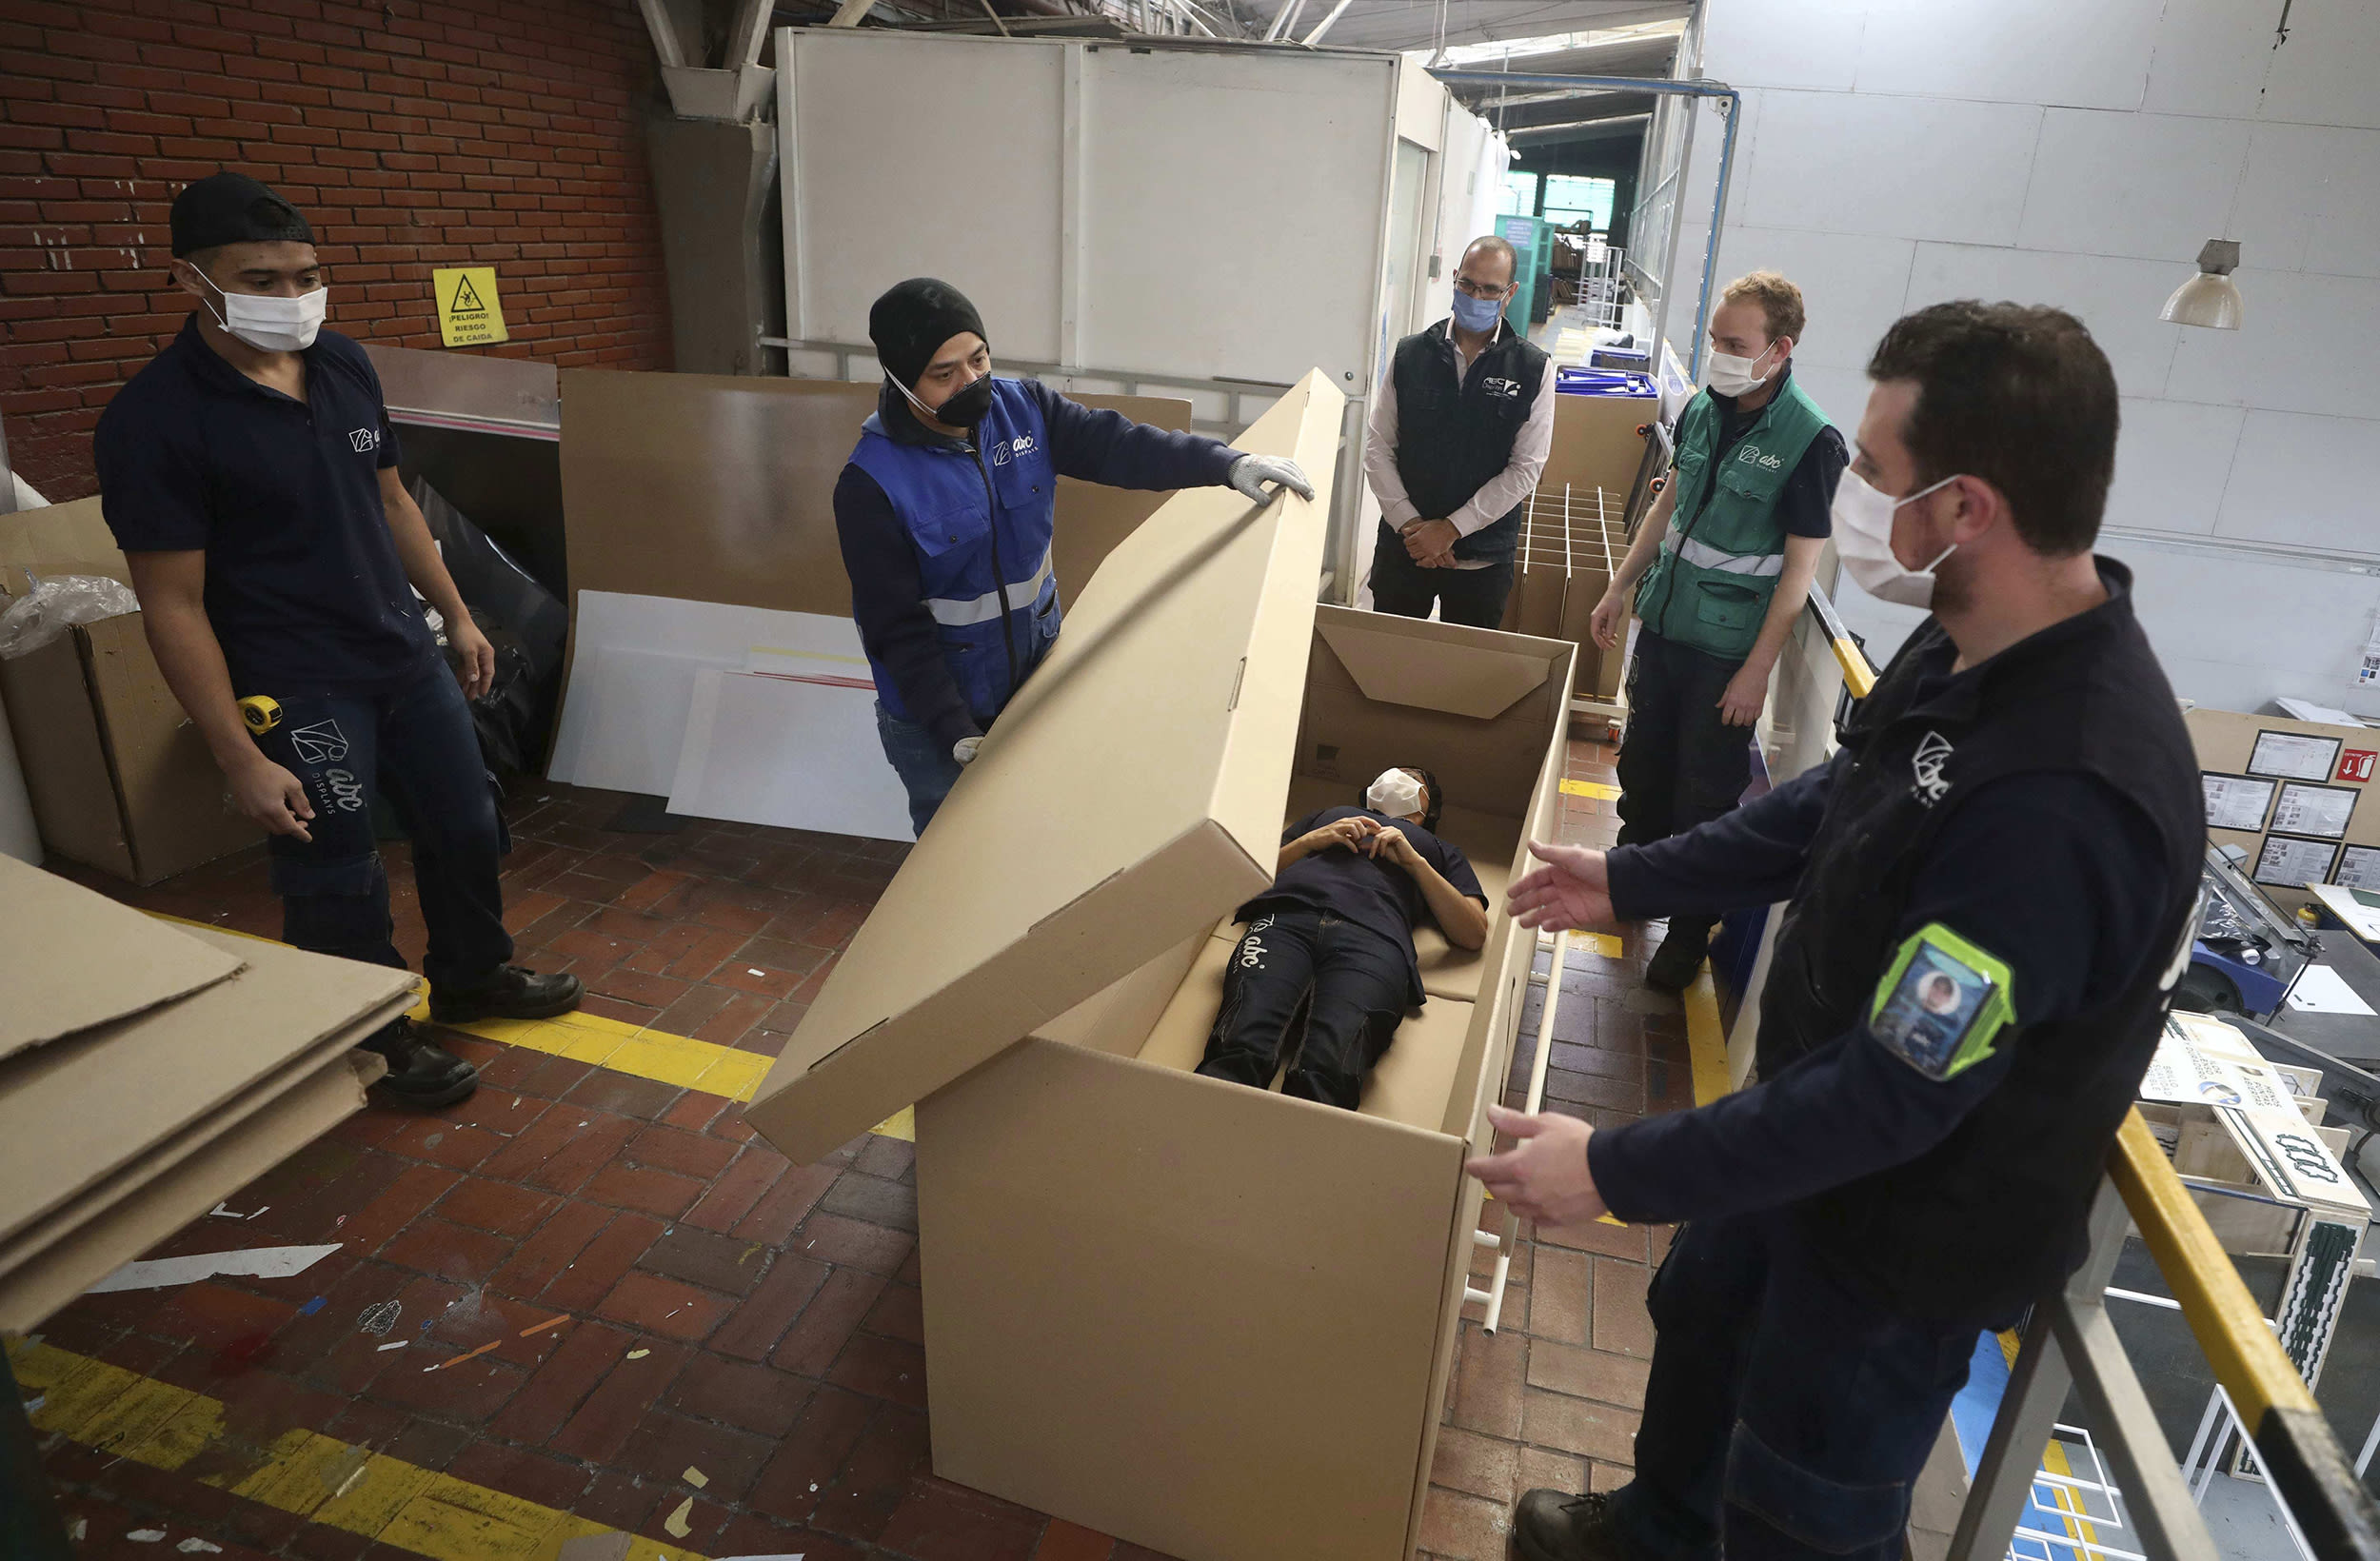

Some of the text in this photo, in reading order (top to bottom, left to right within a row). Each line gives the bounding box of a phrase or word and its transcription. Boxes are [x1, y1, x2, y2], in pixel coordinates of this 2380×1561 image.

[449, 312, 488, 323] ¡PELIGRO!
[455, 324, 486, 332] RIESGO
[1759, 454, 1781, 469] abc
[312, 772, 336, 815] DISPLAYS
[326, 769, 363, 812] abc
[1240, 936, 1268, 968] abc
